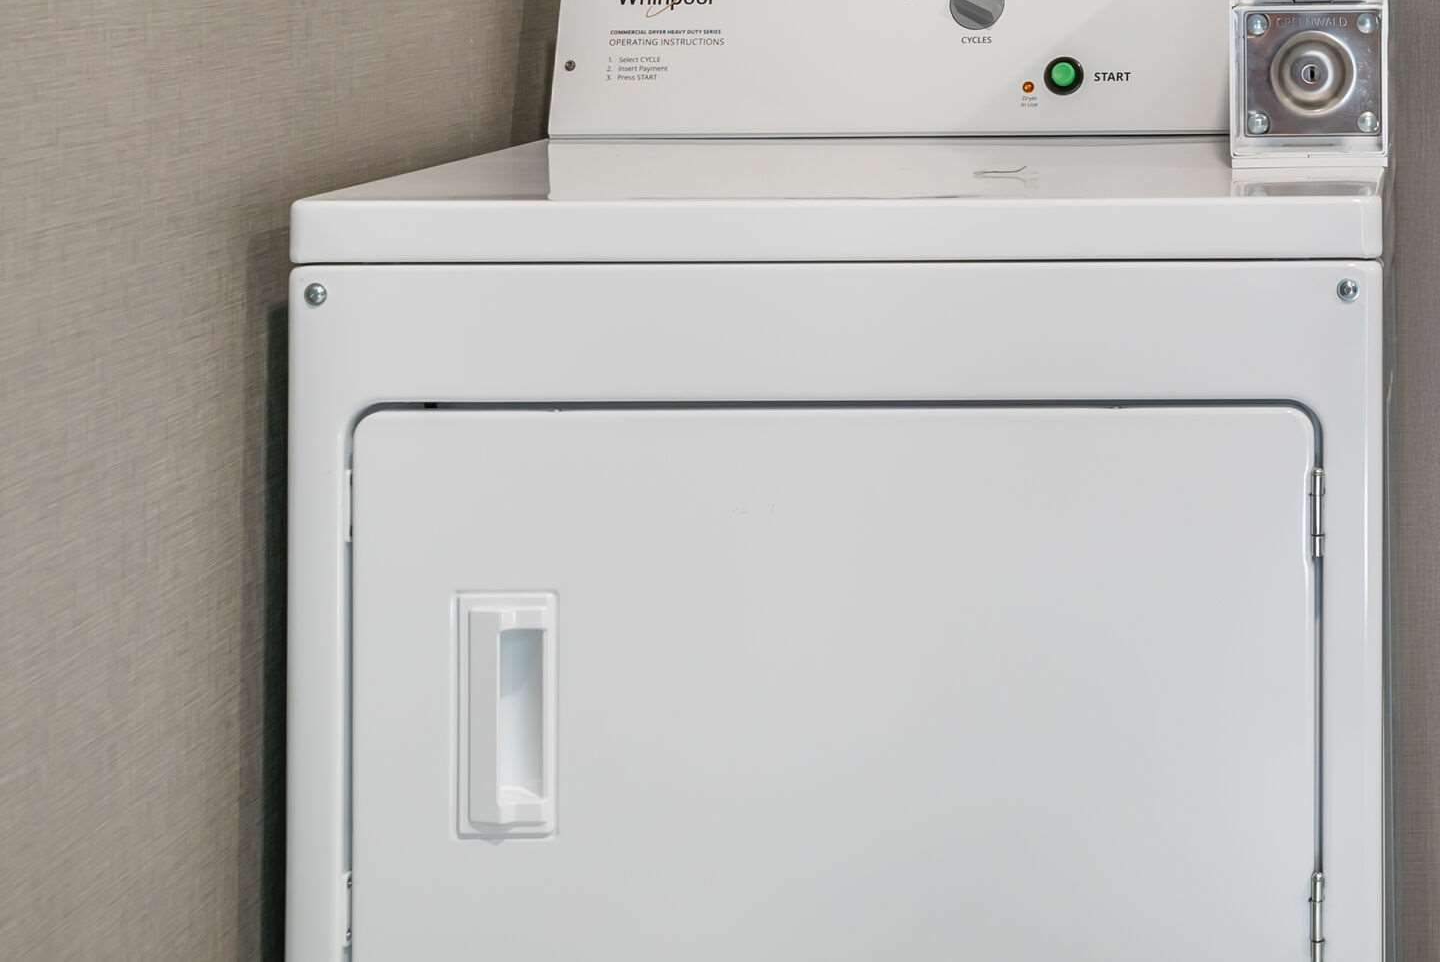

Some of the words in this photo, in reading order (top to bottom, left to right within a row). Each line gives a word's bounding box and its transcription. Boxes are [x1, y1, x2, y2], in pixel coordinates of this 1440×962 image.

[608, 37, 659, 46] OPERATING
[660, 37, 725, 46] INSTRUCTIONS
[961, 36, 993, 44] CYCLES
[618, 65, 638, 73] Insert
[639, 65, 669, 73] Payment
[1093, 72, 1132, 82] START
